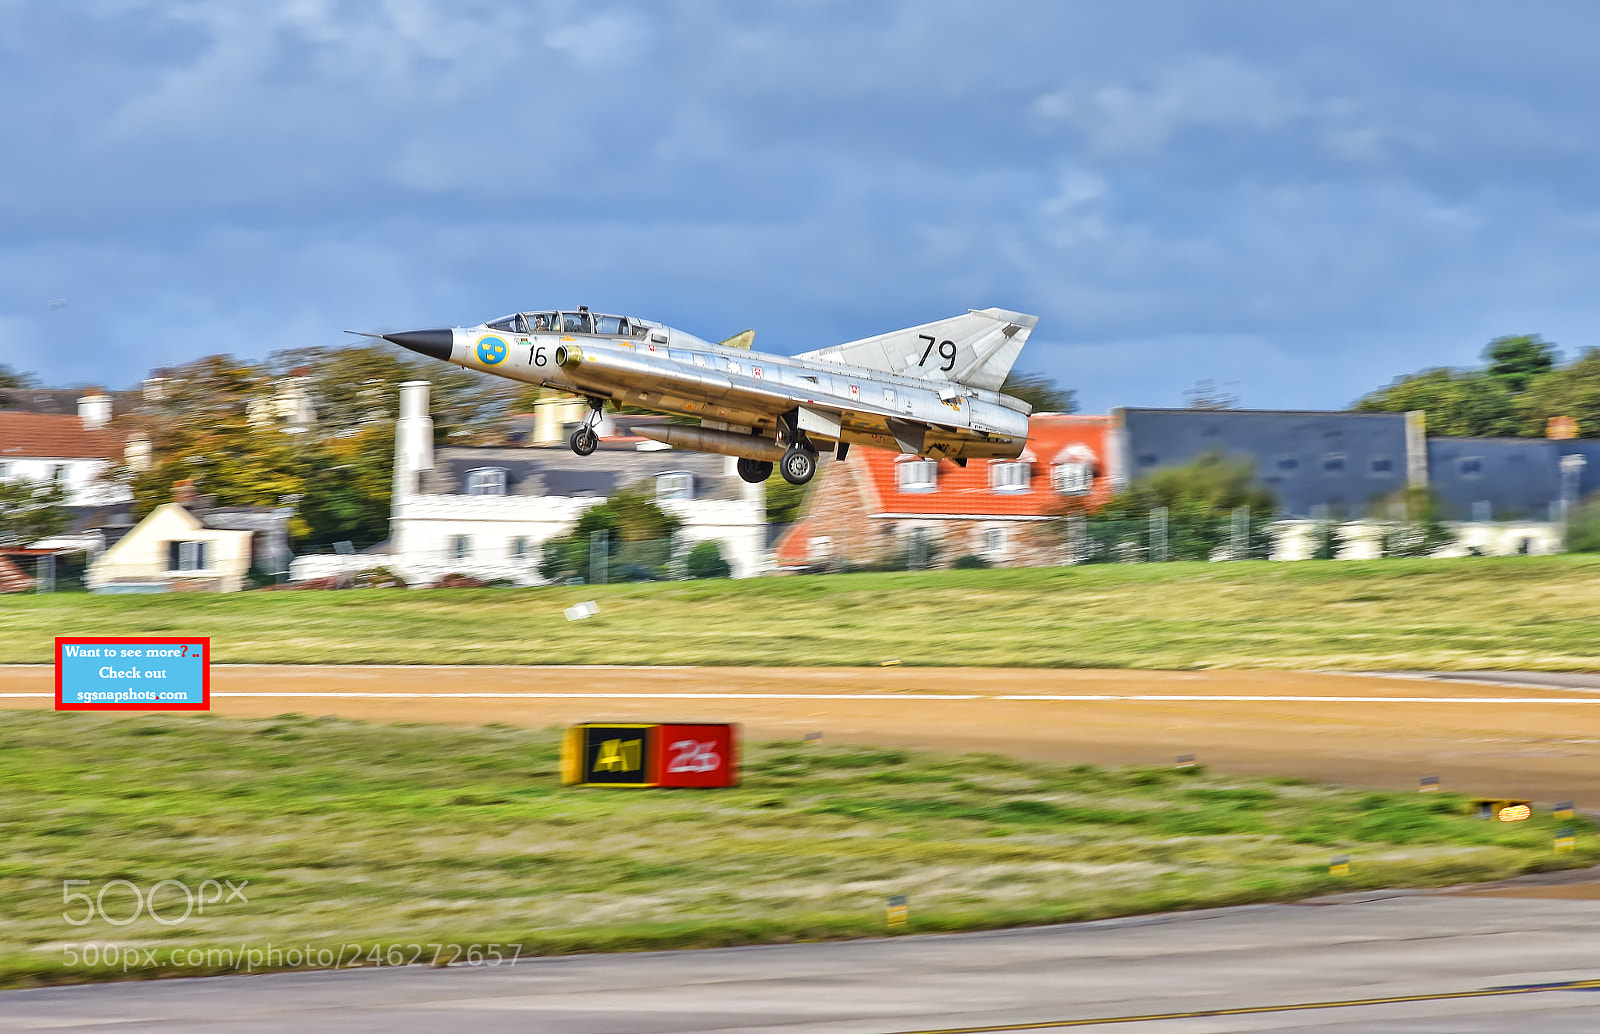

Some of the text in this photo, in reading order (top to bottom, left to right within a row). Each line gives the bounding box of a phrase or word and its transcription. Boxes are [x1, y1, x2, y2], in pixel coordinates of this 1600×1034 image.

[528, 345, 548, 367] 16
[918, 334, 957, 371] 79
[666, 739, 722, 773] 26
